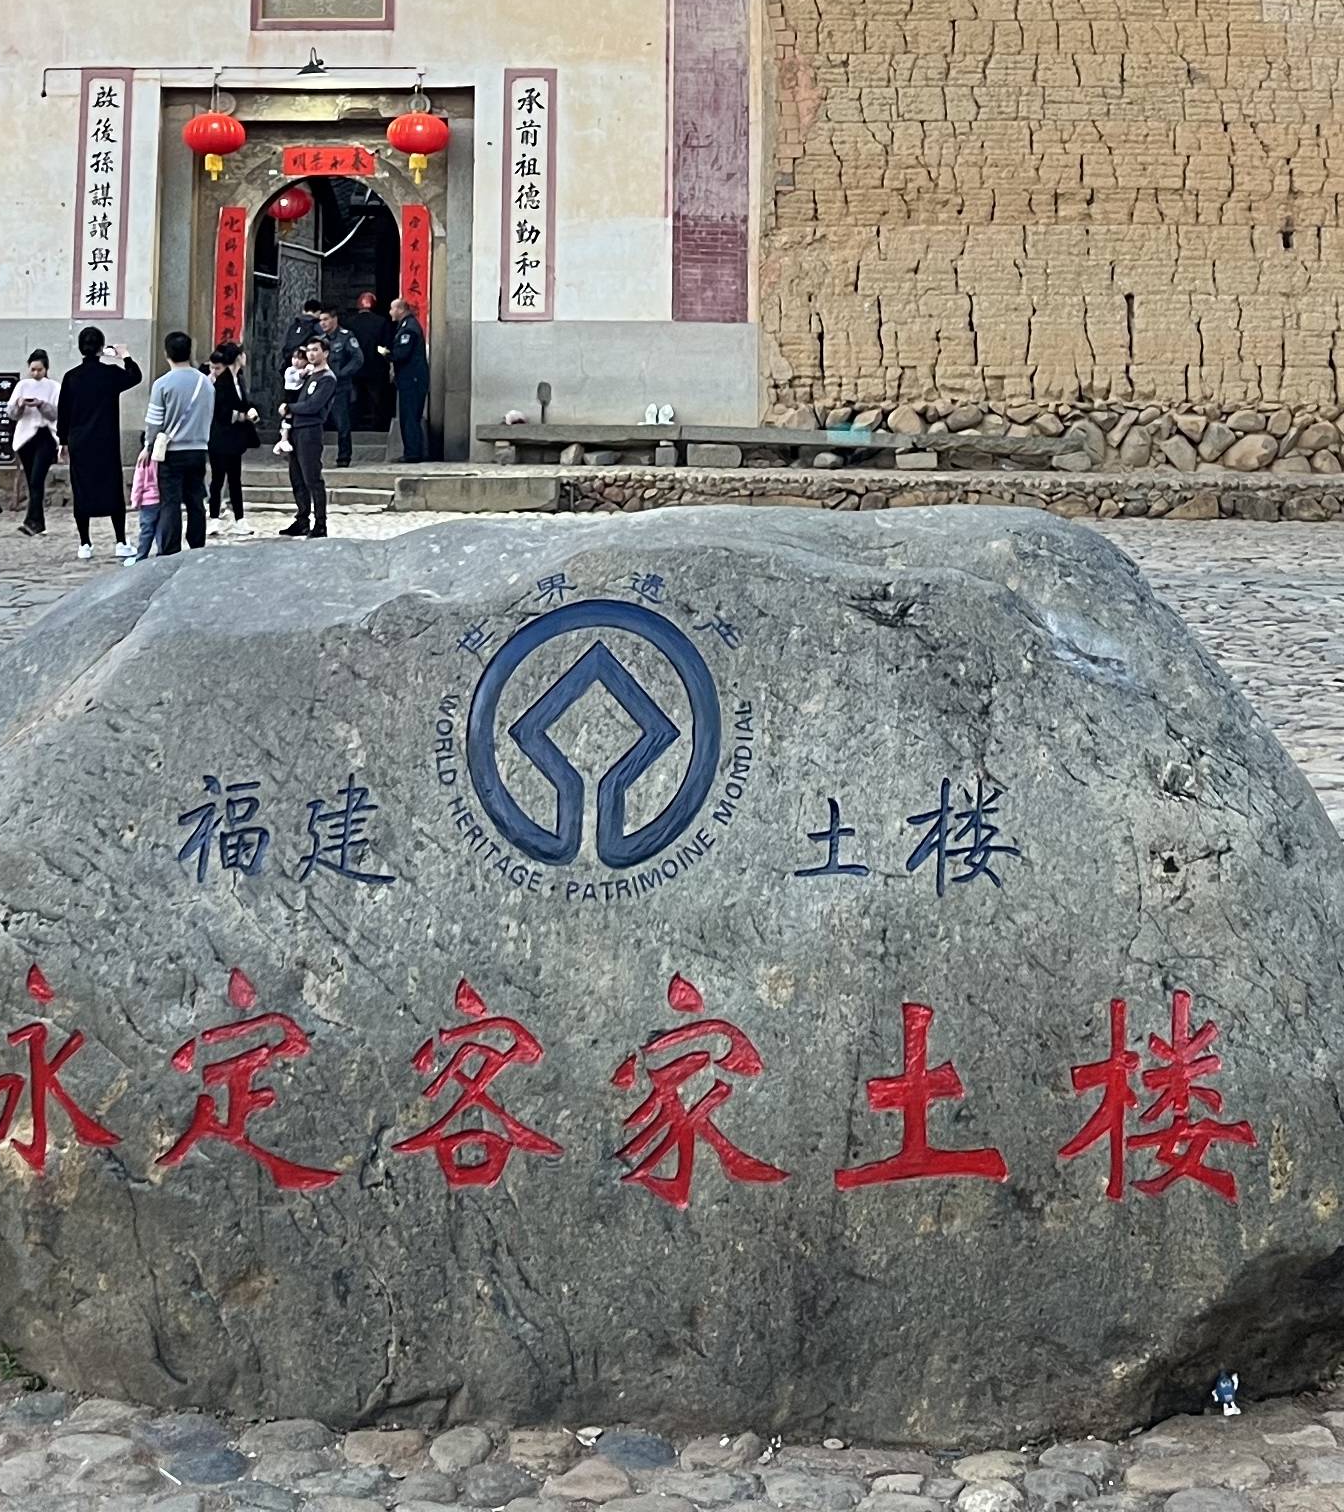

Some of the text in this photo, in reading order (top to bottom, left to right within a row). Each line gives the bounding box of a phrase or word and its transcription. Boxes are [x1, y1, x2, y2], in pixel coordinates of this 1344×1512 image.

[177, 772, 1022, 898] 福建 土楼
[434, 694, 754, 904] WORLD HERITAGE PATRIMOINE MONDIAL
